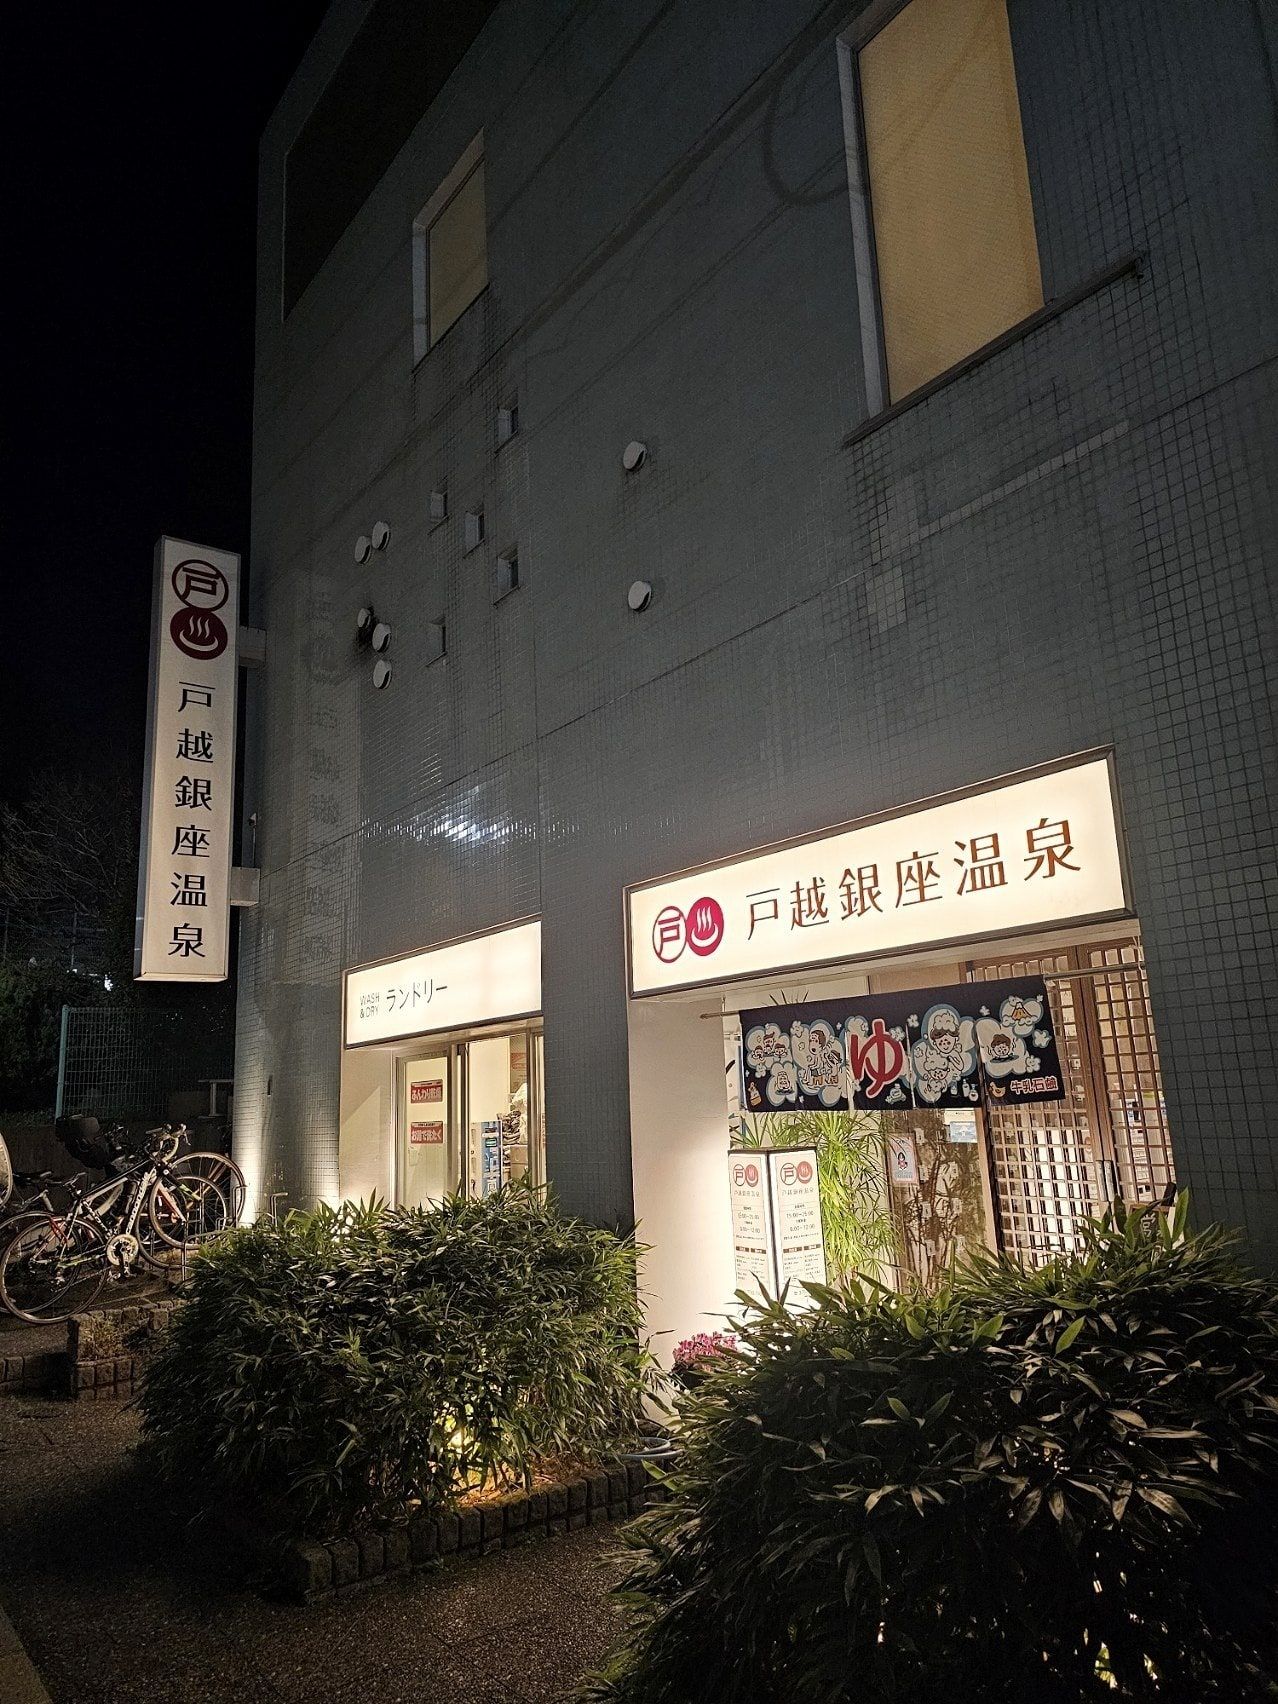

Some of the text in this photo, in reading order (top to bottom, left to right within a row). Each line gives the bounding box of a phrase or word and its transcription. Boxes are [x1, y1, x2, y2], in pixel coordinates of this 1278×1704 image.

[182, 565, 221, 599] 戸
[167, 680, 216, 958] 戸越銀座温泉
[744, 816, 1082, 941] 戸越銀座温泉
[656, 916, 682, 953] 戸
[359, 991, 380, 1006] WASH
[386, 978, 448, 1012] ランドリー
[848, 1017, 906, 1099] ゆ
